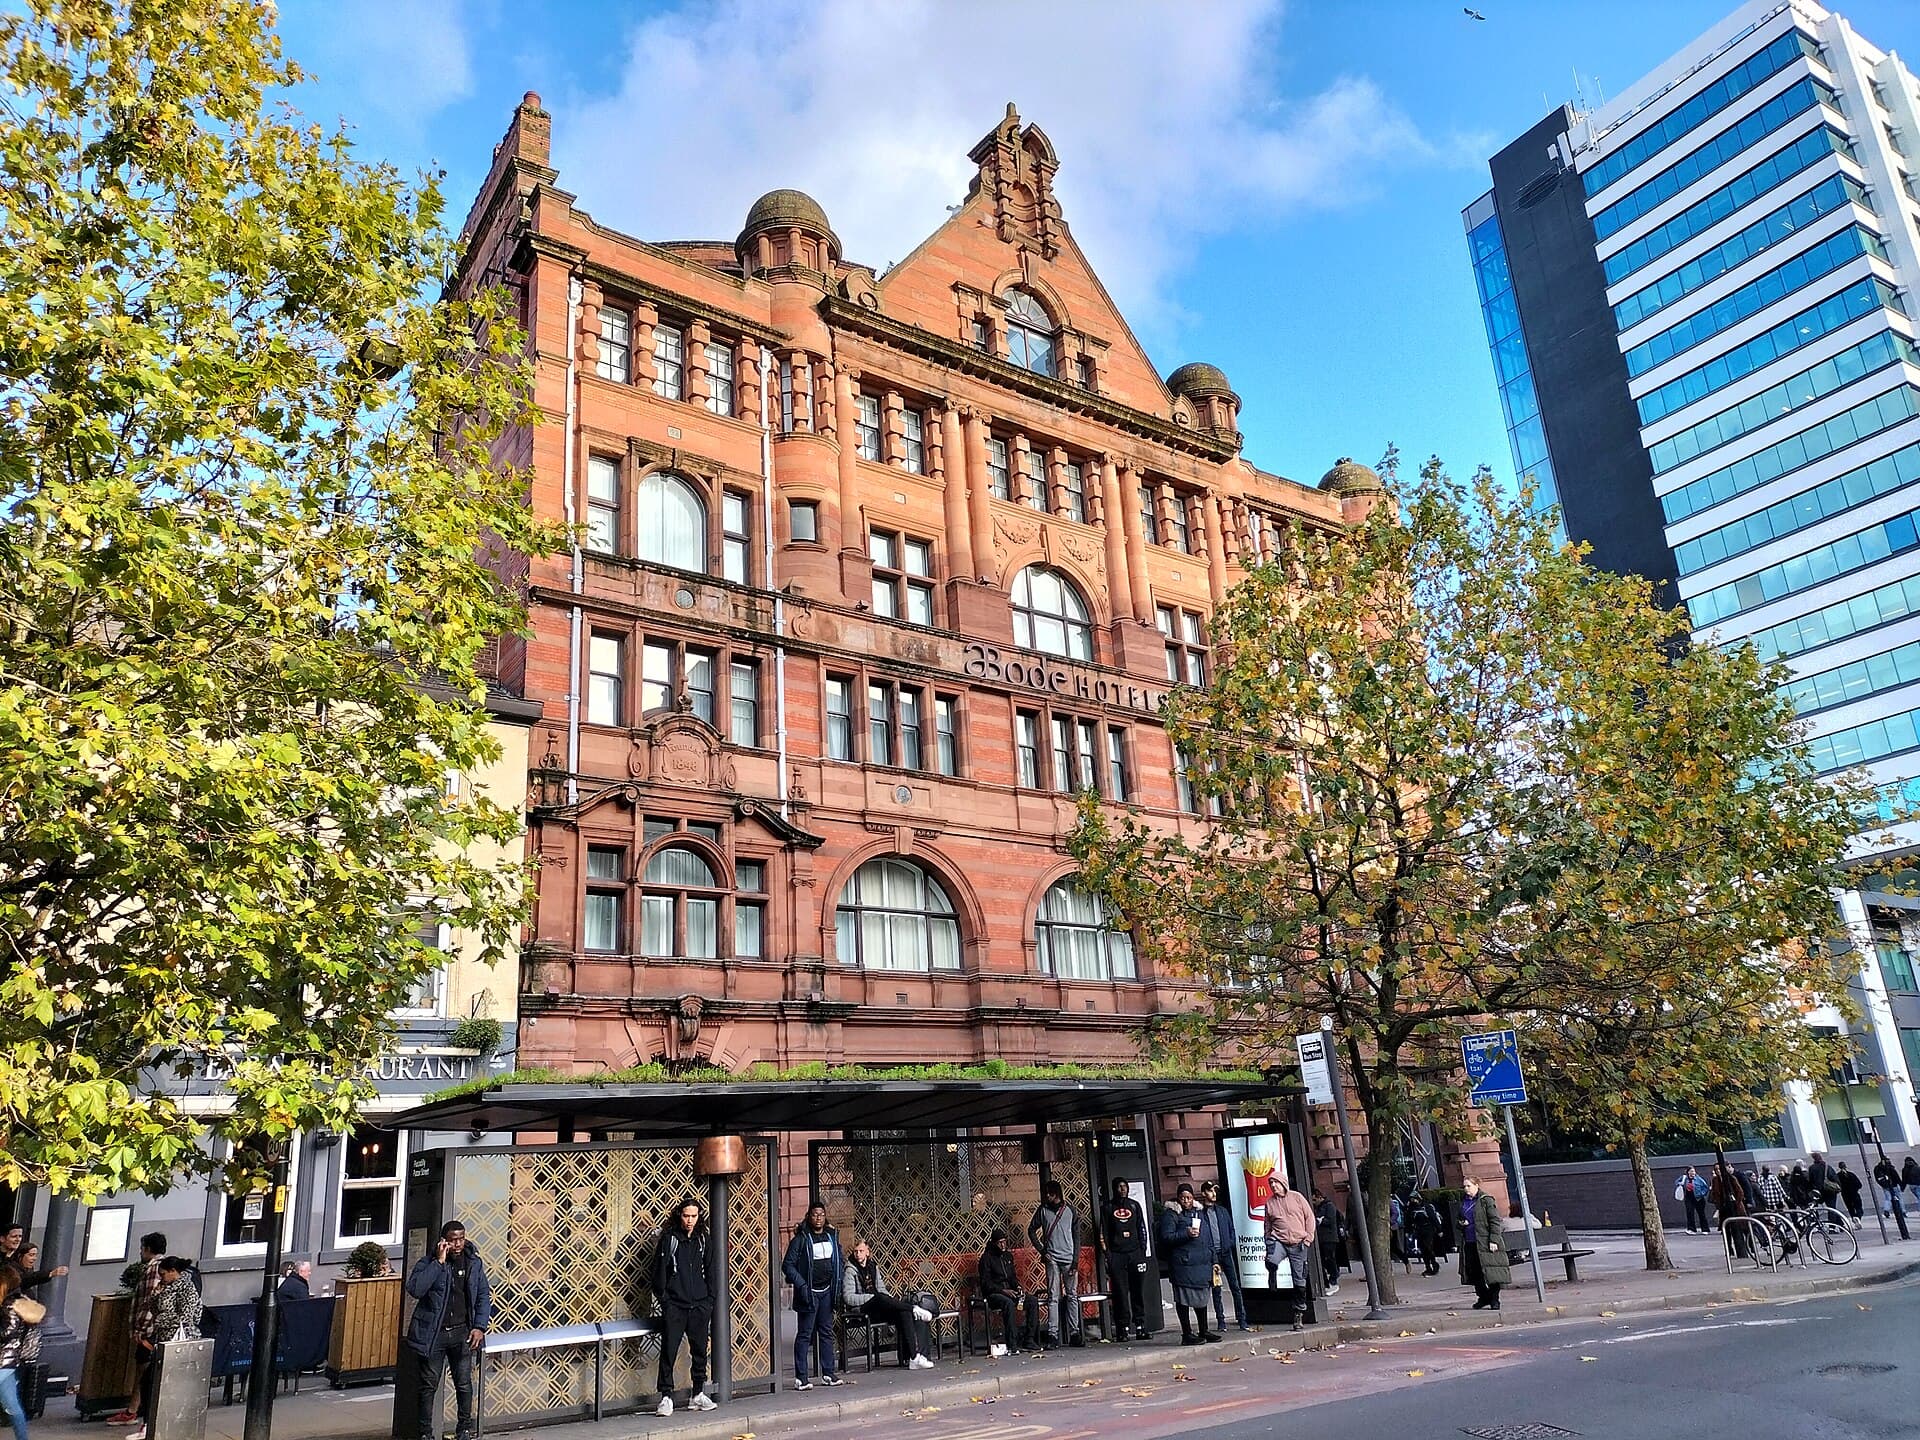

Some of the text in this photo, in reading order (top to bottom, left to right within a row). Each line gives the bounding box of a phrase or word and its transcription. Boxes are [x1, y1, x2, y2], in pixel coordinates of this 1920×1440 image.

[1075, 674, 1170, 711] HOTELS
[1502, 1092, 1517, 1100] time
[1238, 1235, 1253, 1244] Now
[1239, 1244, 1250, 1254] Fry
